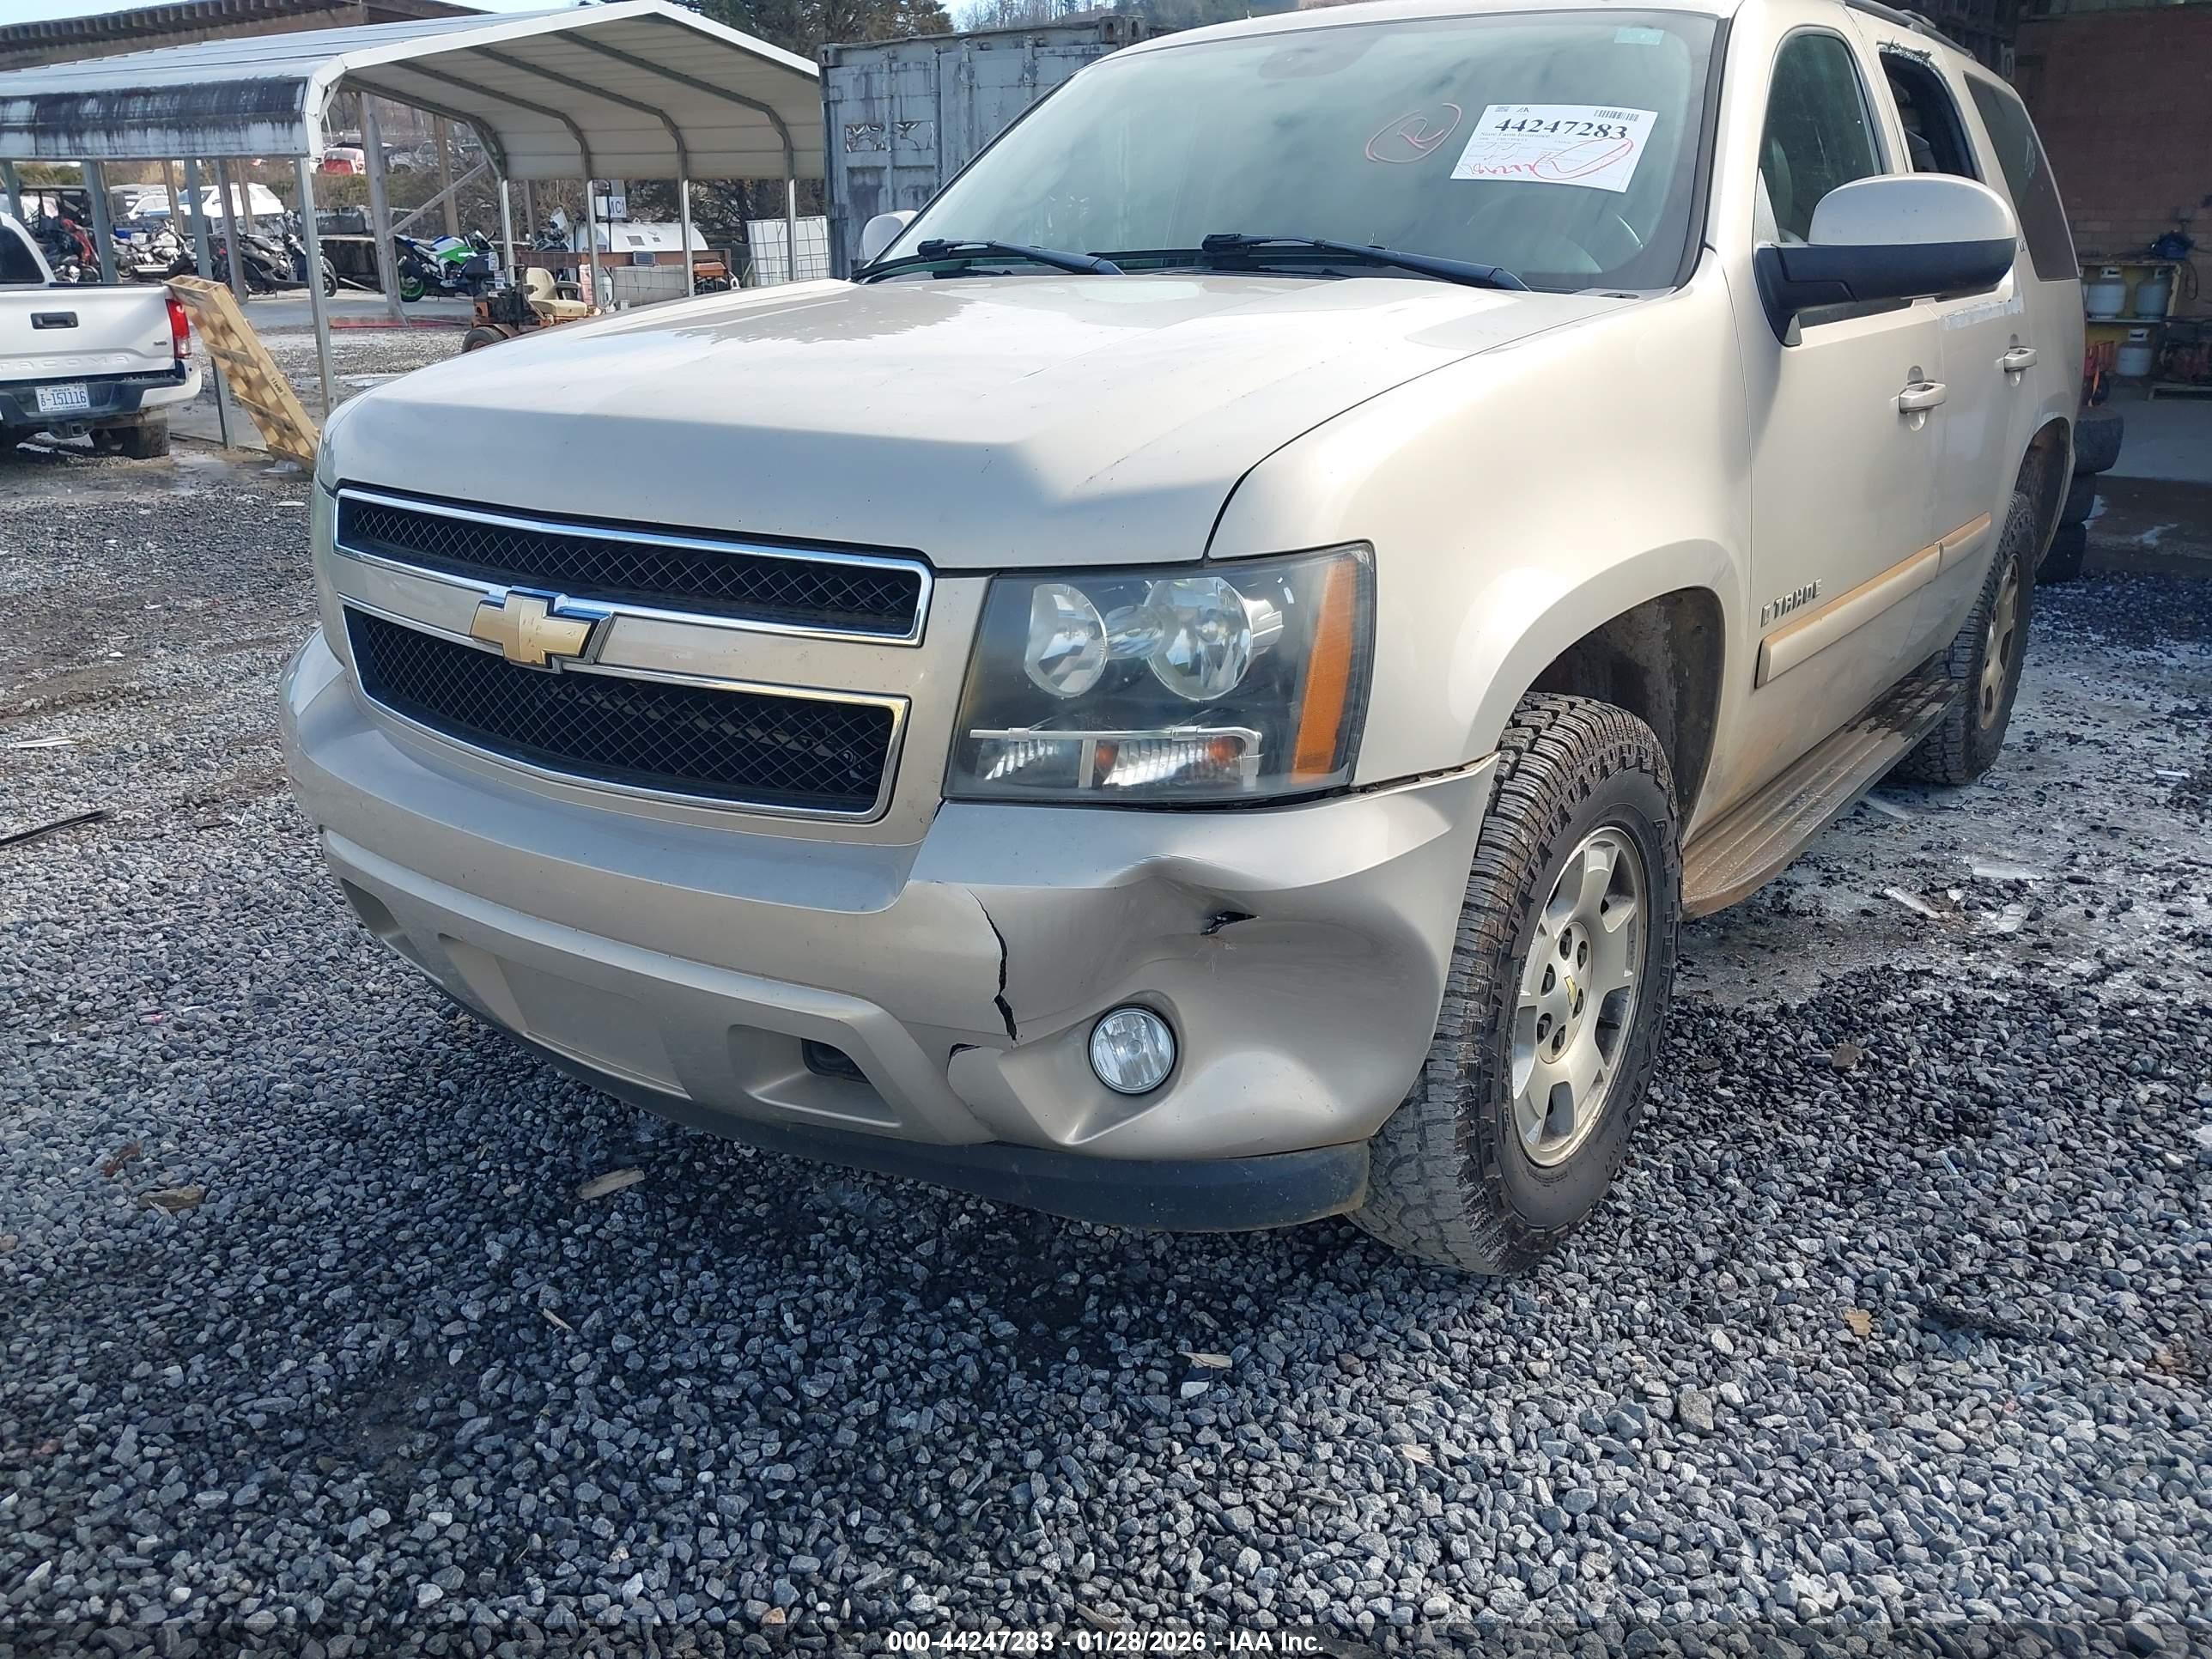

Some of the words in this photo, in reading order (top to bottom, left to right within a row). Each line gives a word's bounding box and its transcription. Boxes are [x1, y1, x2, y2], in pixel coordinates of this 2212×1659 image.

[1494, 118, 1628, 140] 44247283
[0, 354, 130, 372] TACOMA
[1772, 577, 1822, 619] TAHOE
